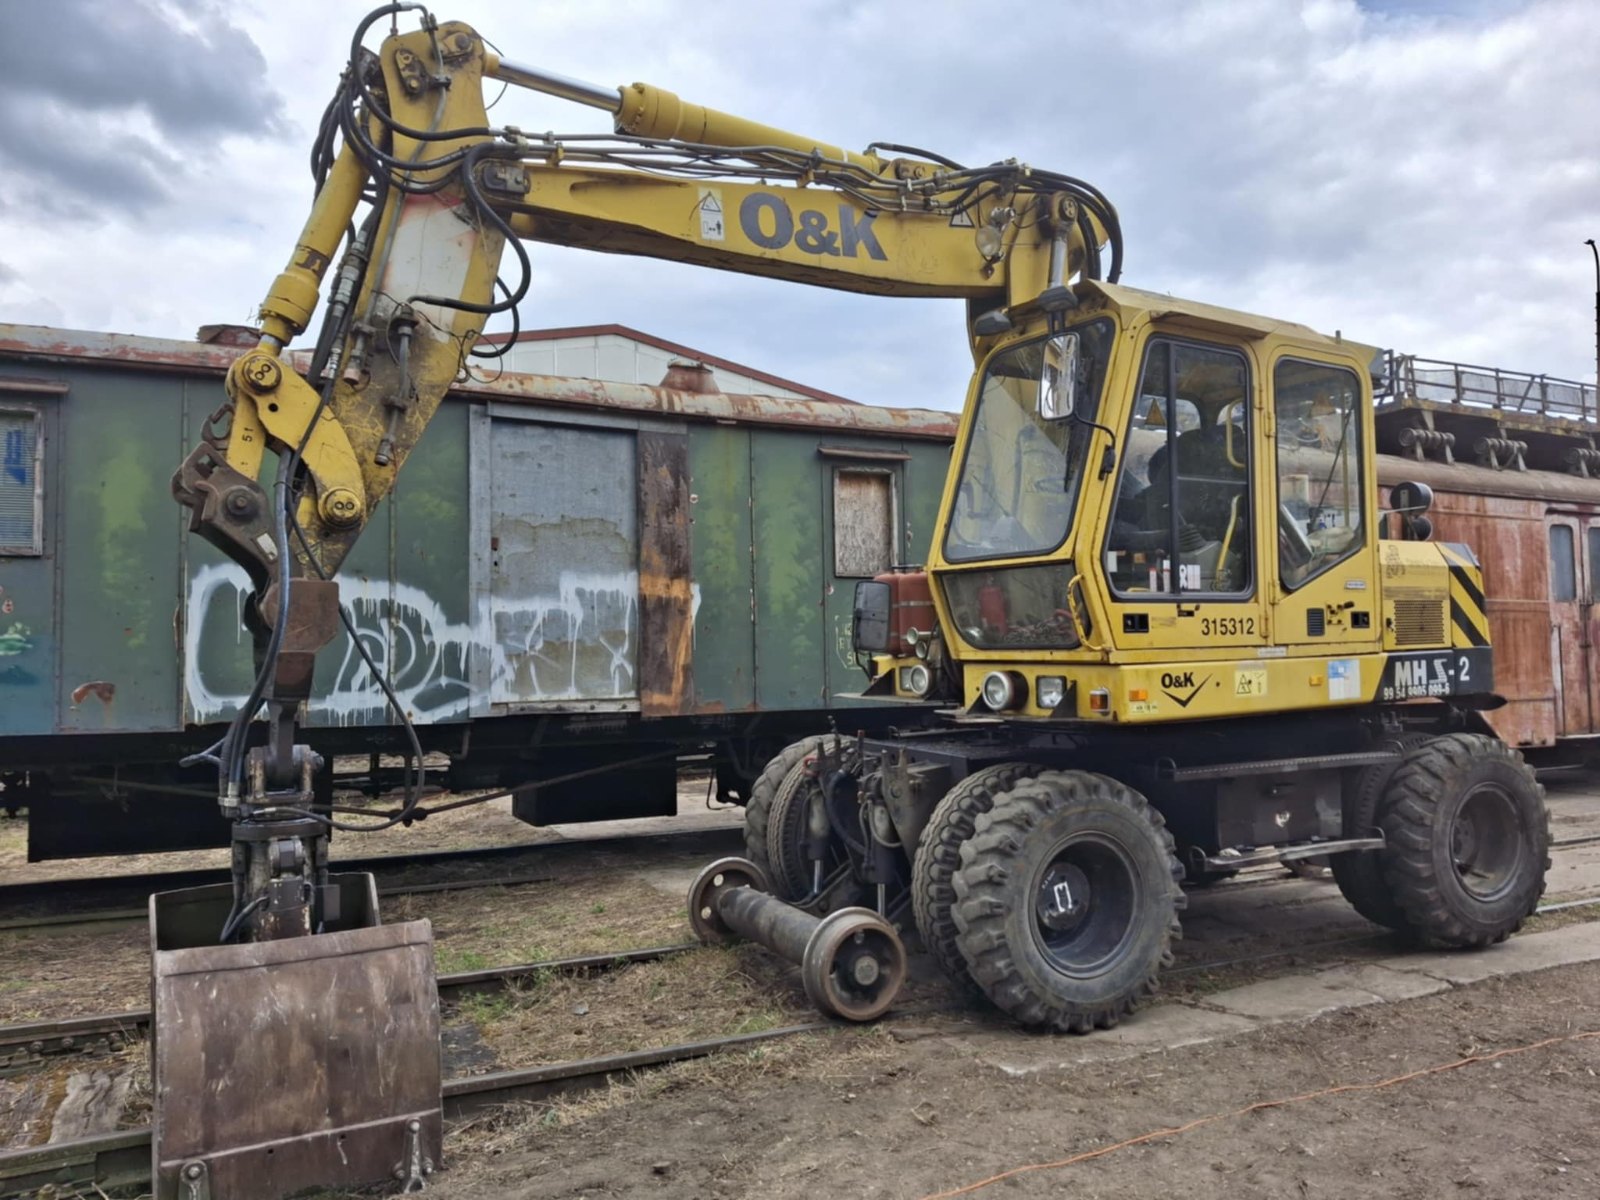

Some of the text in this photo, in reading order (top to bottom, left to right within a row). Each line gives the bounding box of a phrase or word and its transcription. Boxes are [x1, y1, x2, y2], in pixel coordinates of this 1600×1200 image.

[740, 192, 888, 261] O&K
[1201, 618, 1254, 635] 315312
[1161, 672, 1195, 688] O&K
[1395, 660, 1427, 686] MH
